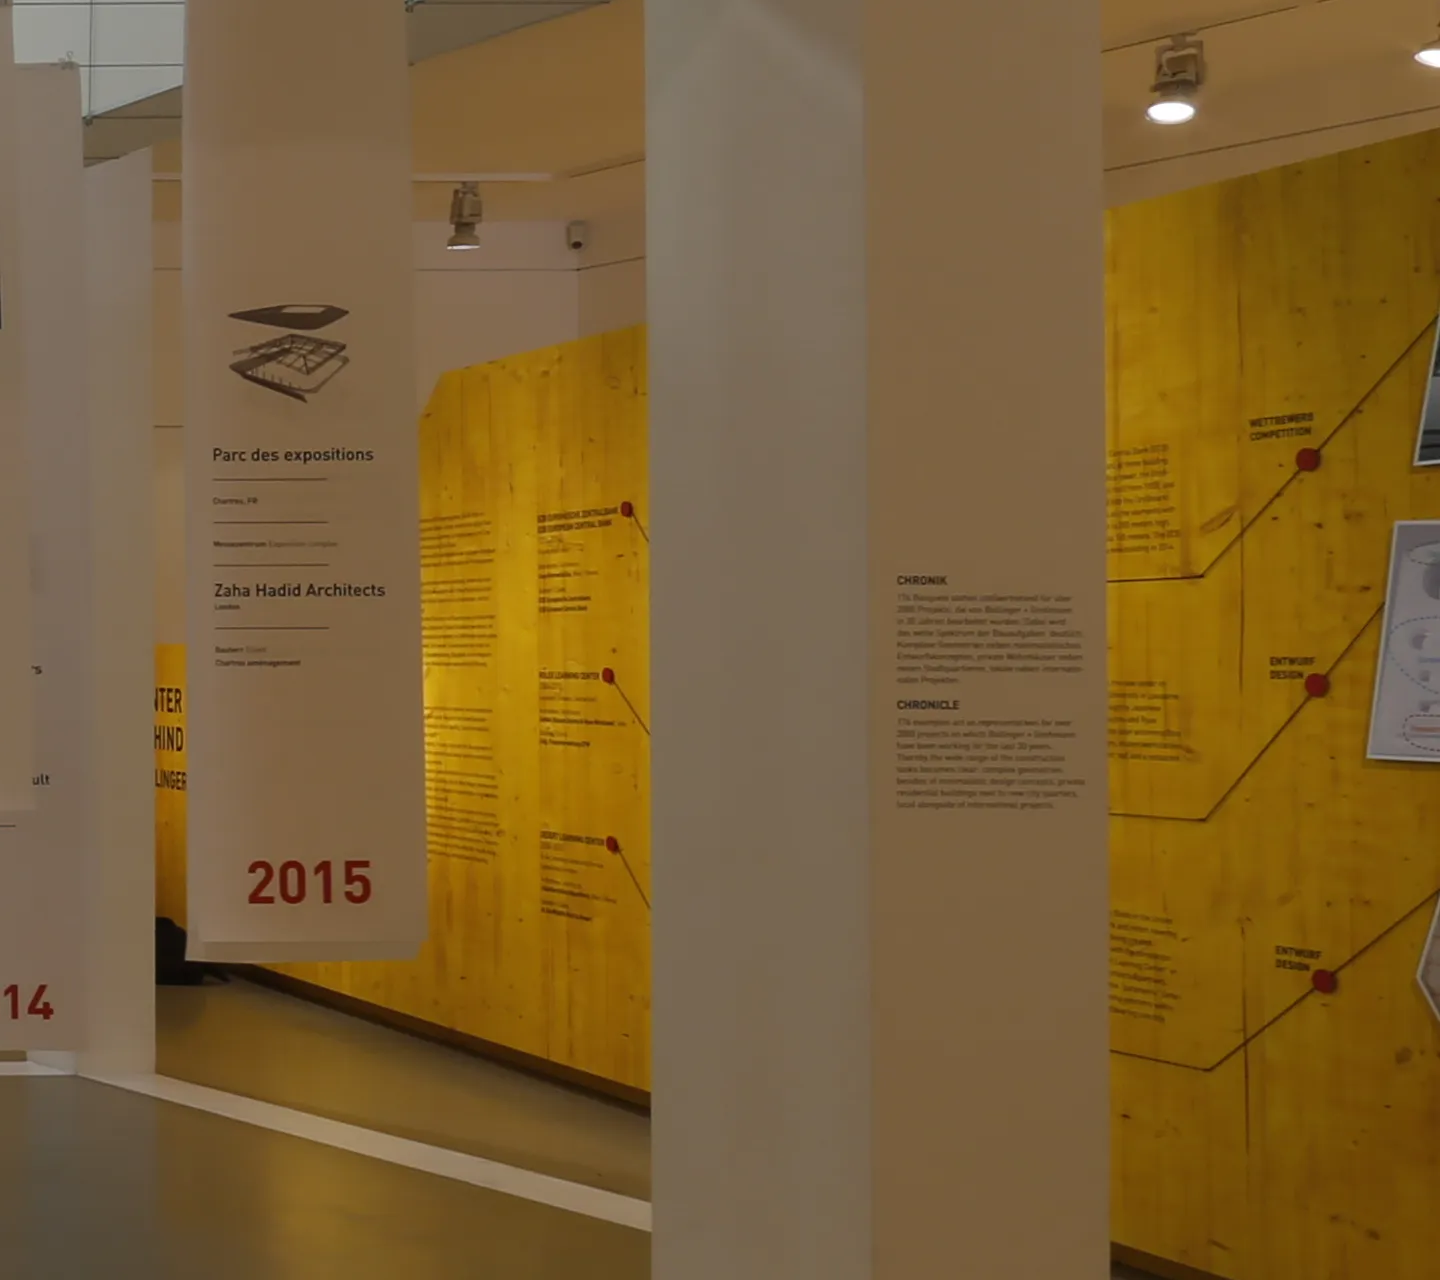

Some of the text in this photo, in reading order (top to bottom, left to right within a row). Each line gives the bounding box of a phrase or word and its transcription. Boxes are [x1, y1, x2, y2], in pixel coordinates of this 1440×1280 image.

[1250, 426, 1312, 441] COMPETITION
[213, 448, 374, 464] Parc des expositions
[897, 576, 947, 585] CHRONIK
[215, 583, 385, 597] Zaha Hadid Architects
[1269, 670, 1304, 680] DESIGN
[897, 700, 959, 710] CHRONICLE
[248, 861, 371, 904] 2015
[1276, 959, 1310, 971] DESIGN
